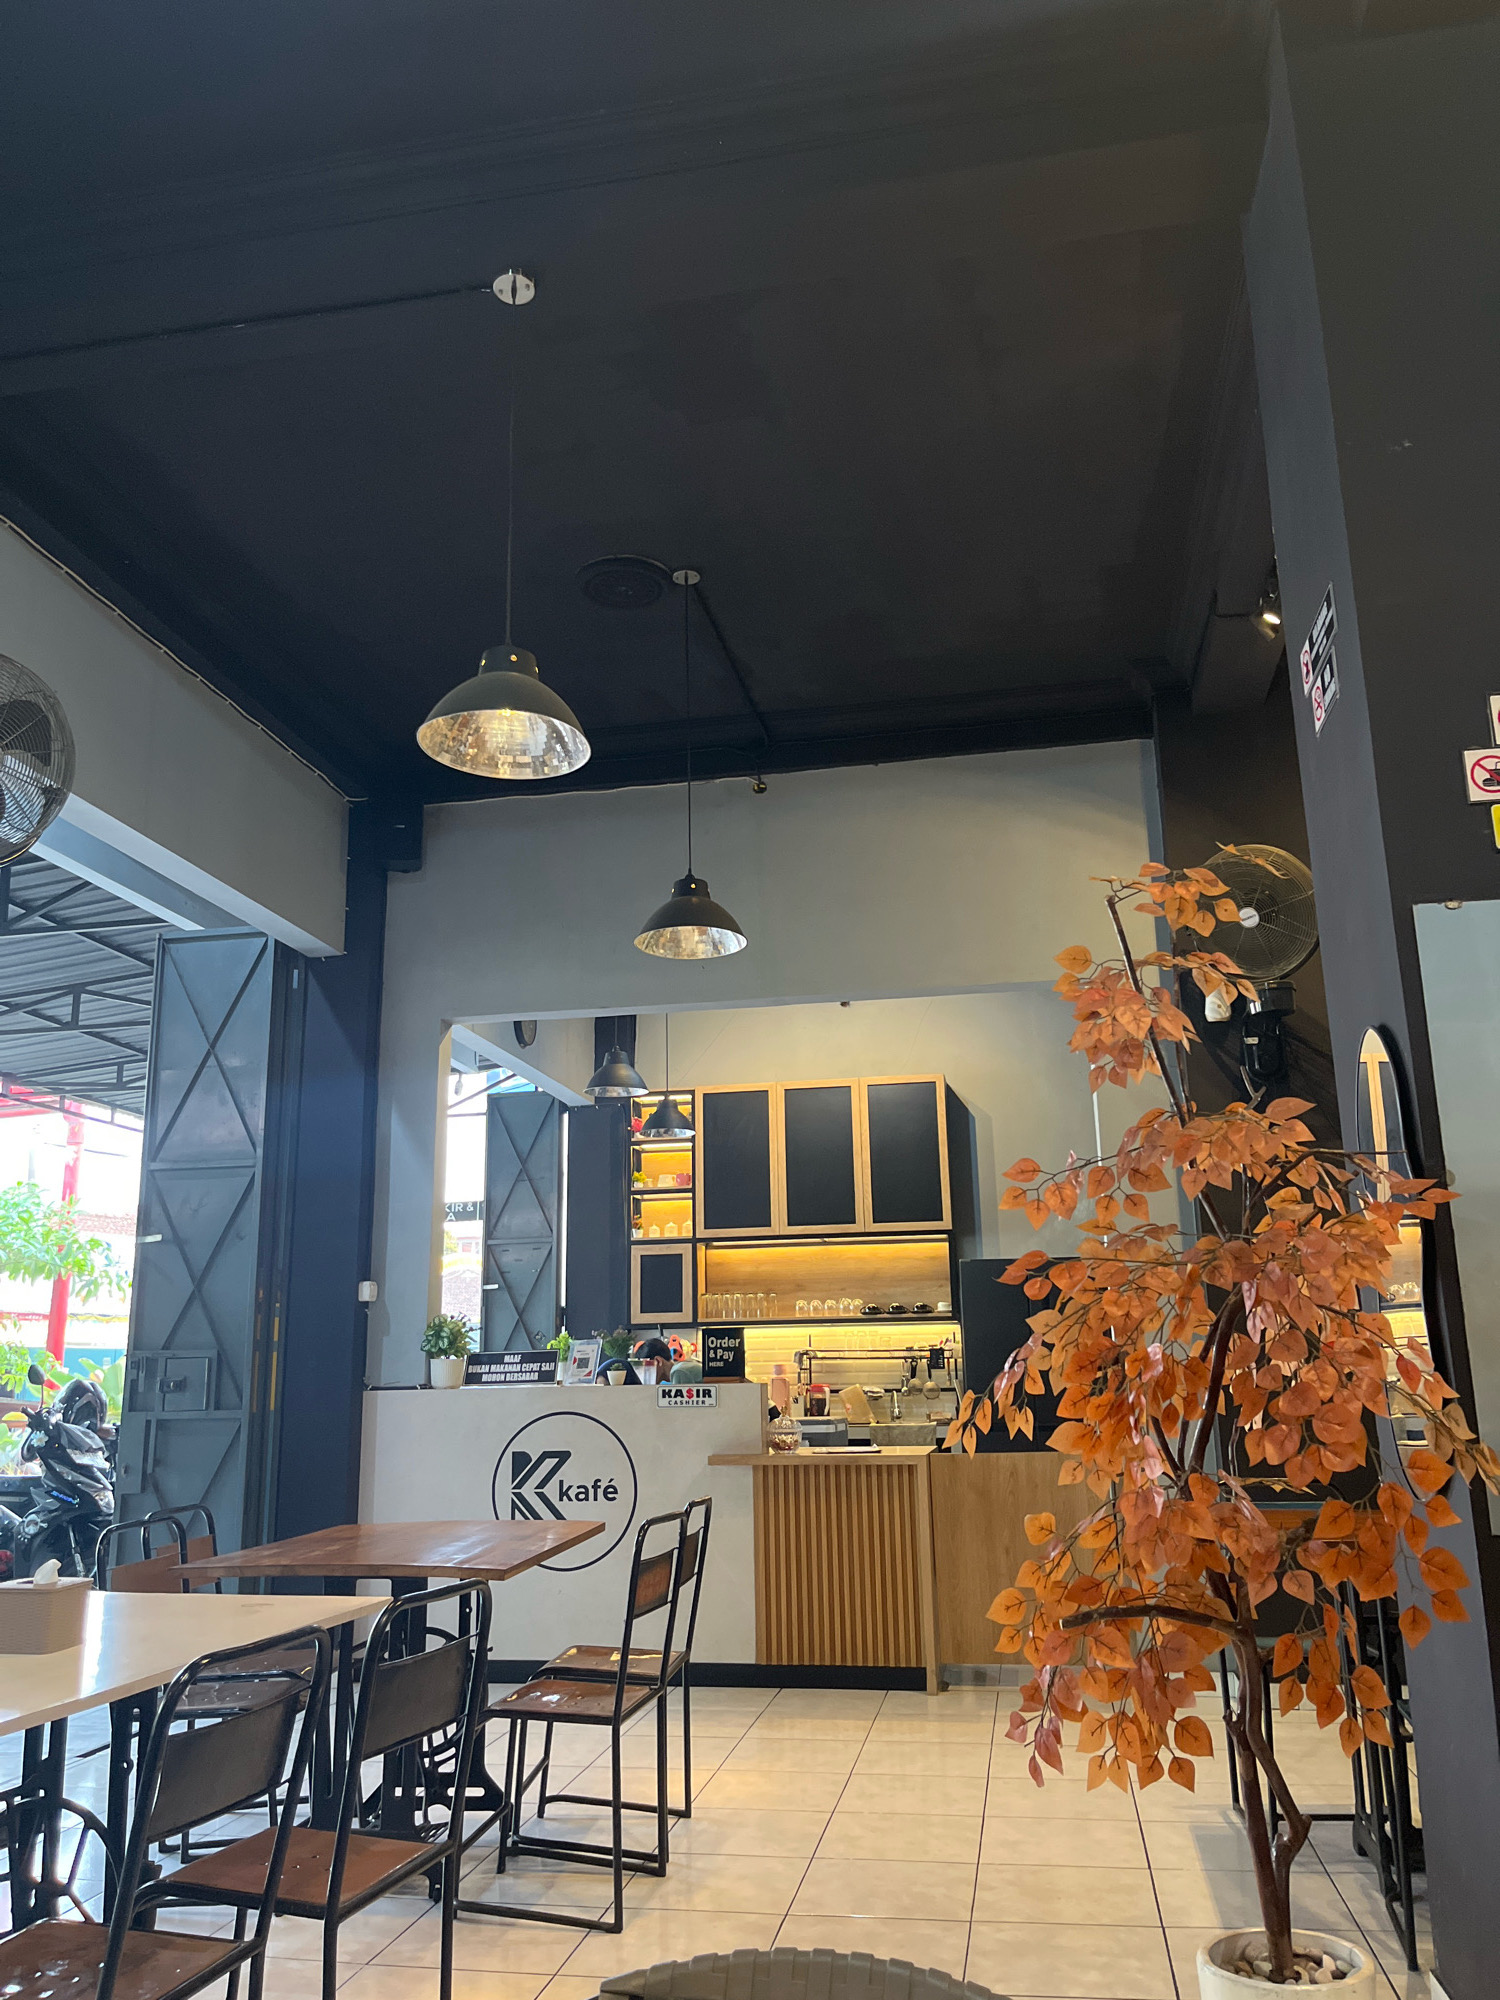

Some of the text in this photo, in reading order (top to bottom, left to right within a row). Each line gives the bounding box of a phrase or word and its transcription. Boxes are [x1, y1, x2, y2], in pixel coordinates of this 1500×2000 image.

[708, 1337, 740, 1348] Order
[504, 1355, 522, 1363] MAAF
[709, 1349, 734, 1362] & Pay
[468, 1362, 555, 1373] BUKAN MAKANAN CEPAT SAJI
[559, 1478, 618, 1502] kafé
